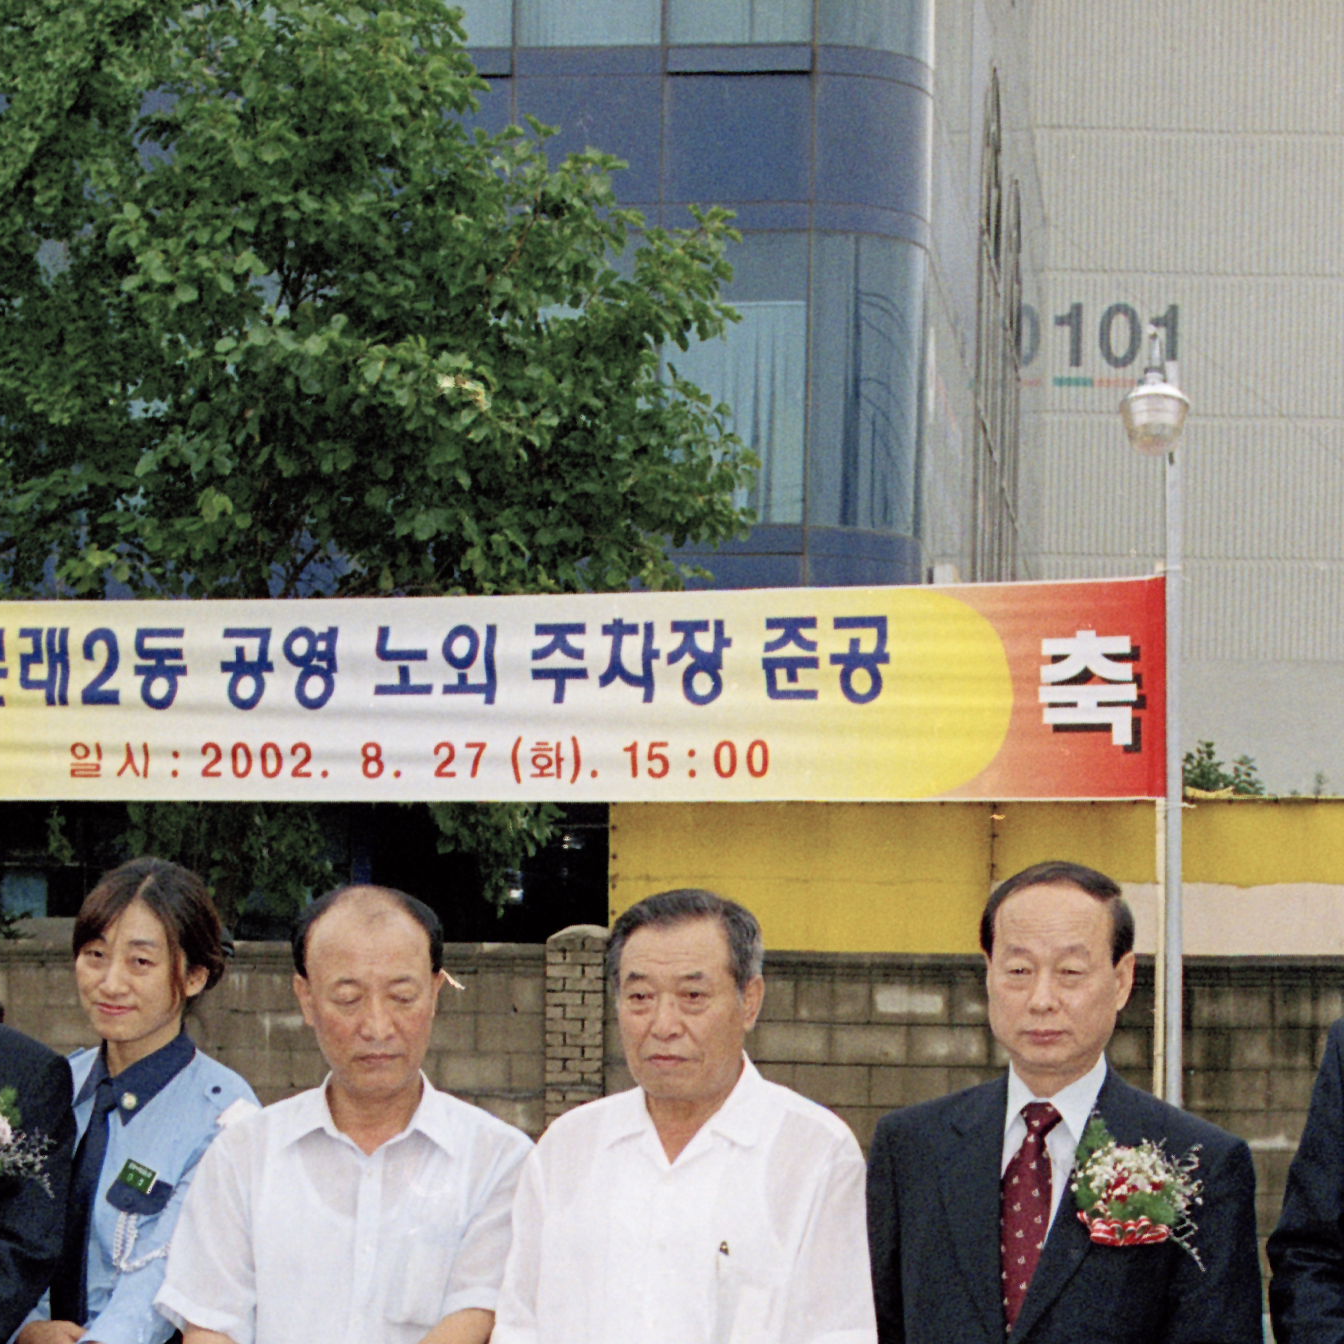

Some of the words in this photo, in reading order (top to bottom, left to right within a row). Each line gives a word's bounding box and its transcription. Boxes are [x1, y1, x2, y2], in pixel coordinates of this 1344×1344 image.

[221, 626, 340, 710] 공영
[375, 623, 497, 705] 노외
[531, 618, 732, 705] 주차장
[762, 615, 890, 704] 준공
[1038, 629, 1139, 747] 축
